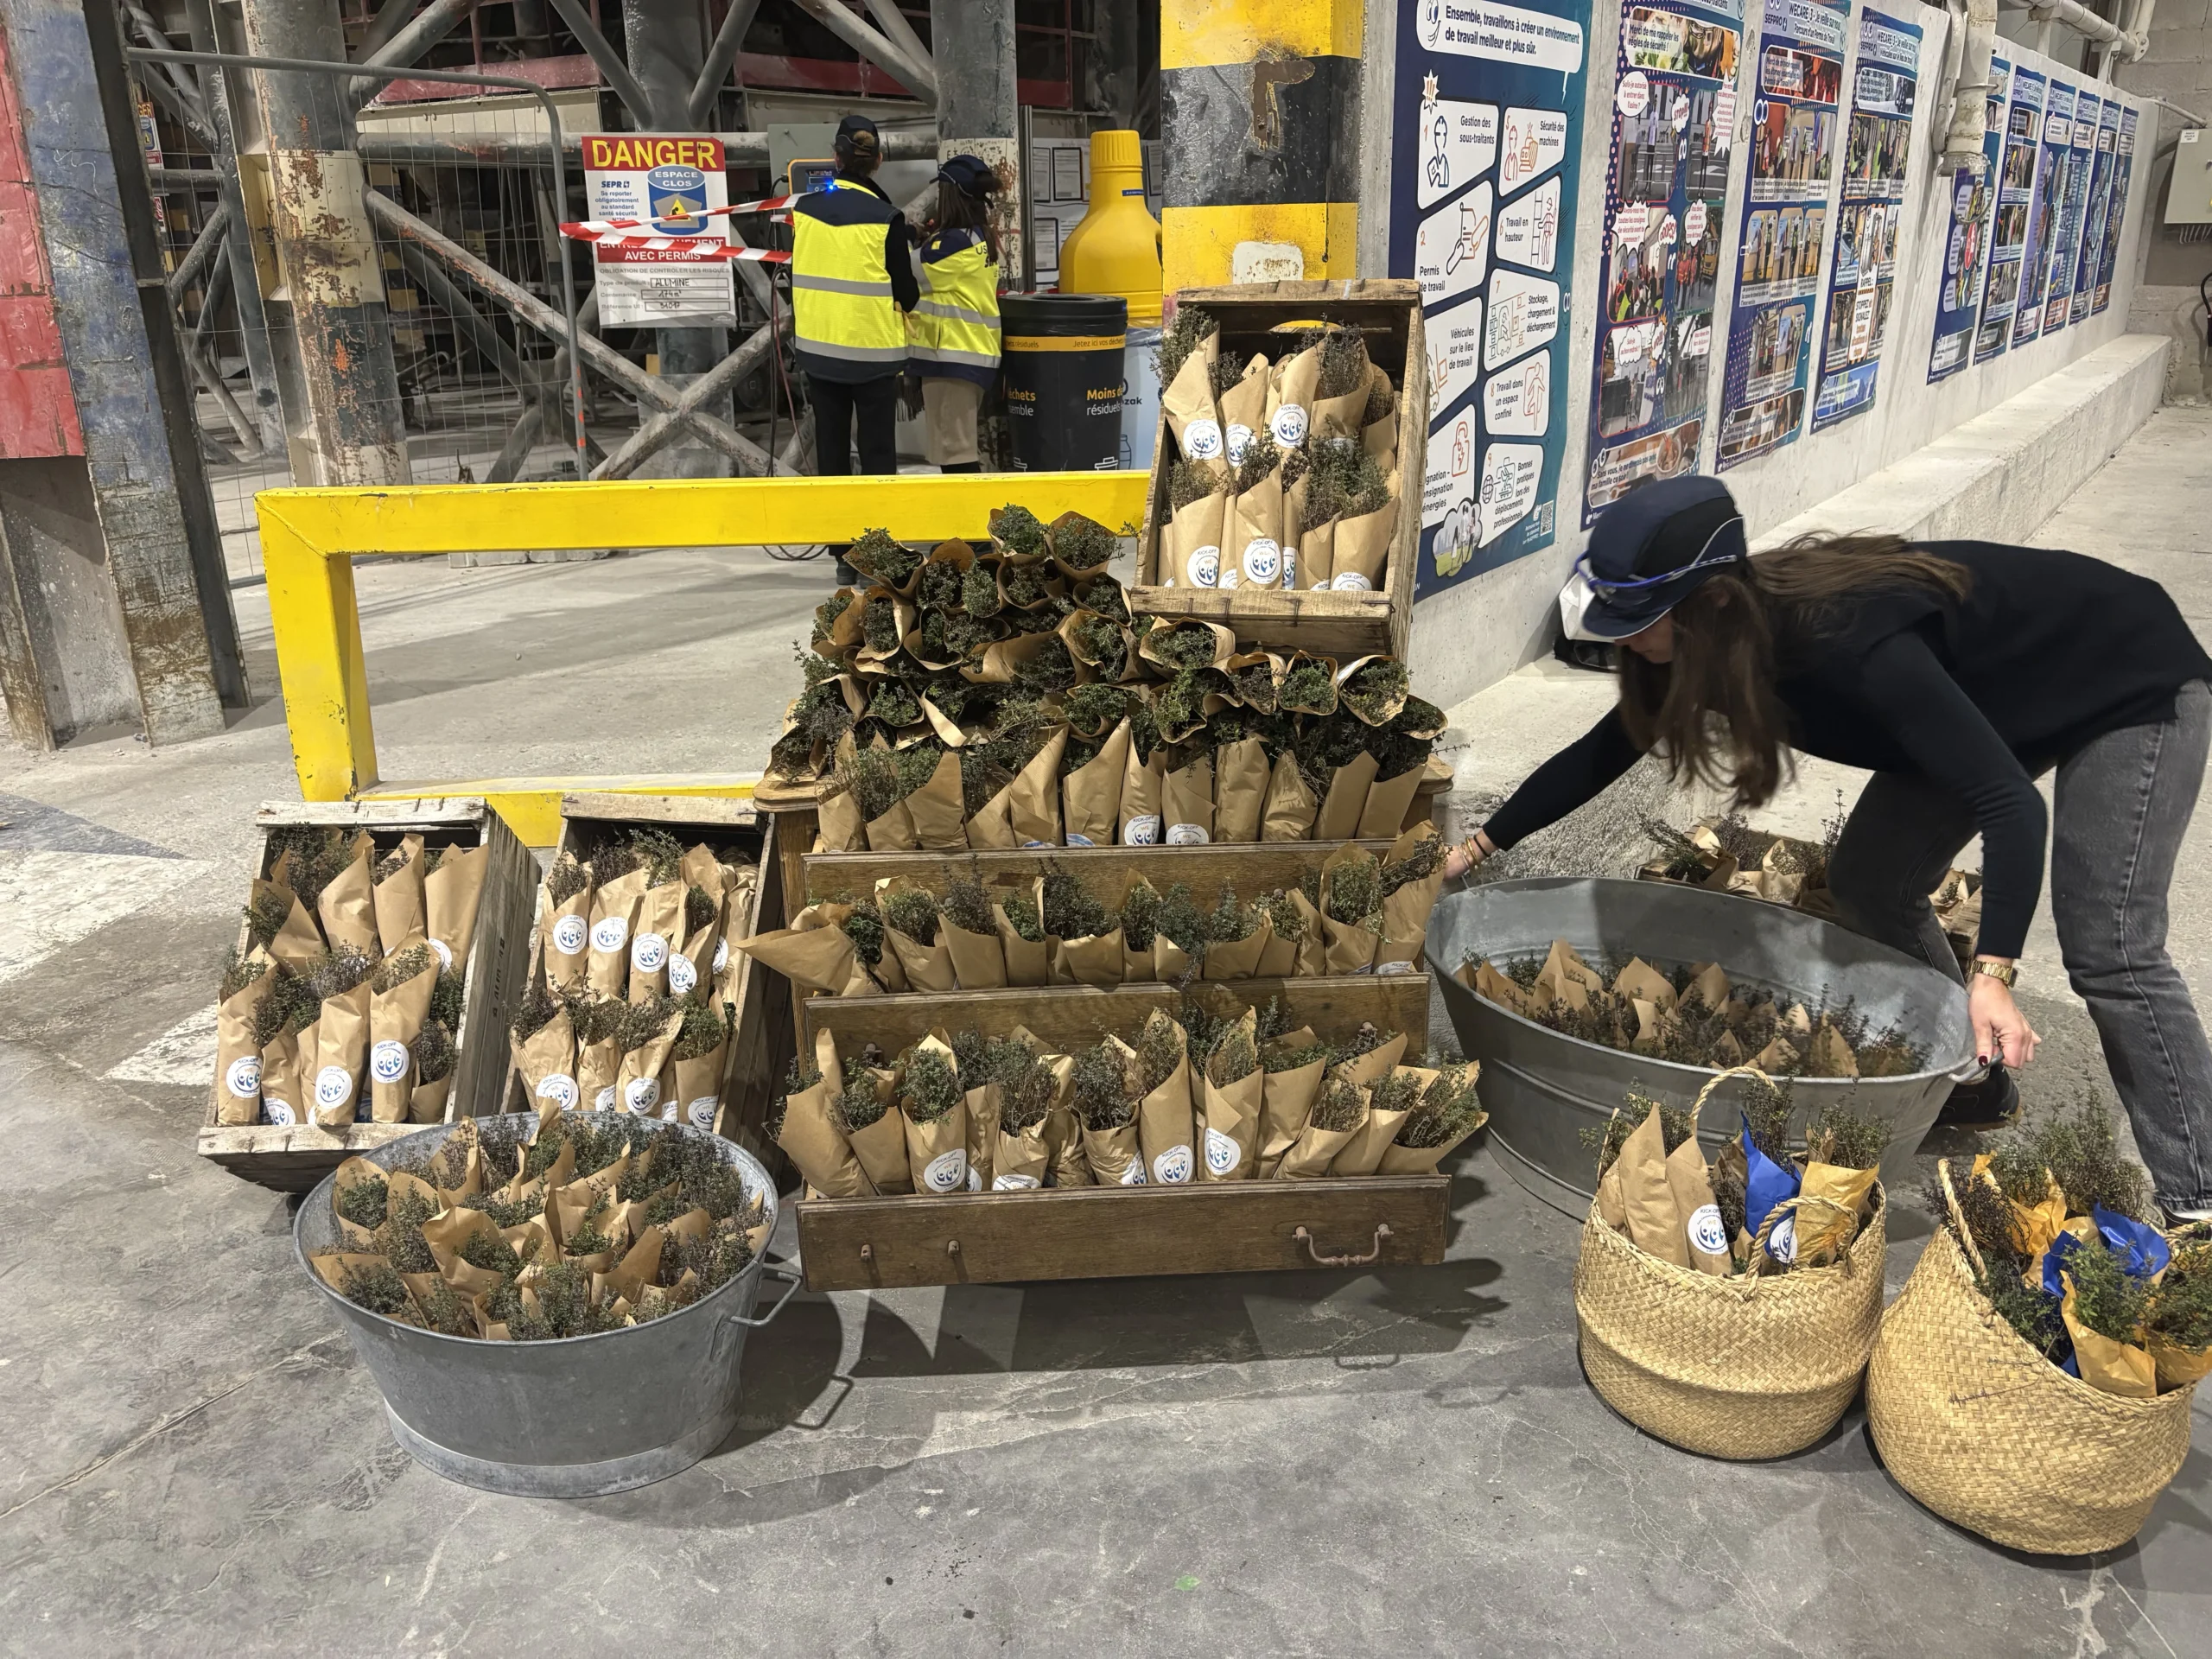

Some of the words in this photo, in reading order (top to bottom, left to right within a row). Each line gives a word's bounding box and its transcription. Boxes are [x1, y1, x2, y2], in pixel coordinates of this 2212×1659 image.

[1446, 6, 1482, 27] Ensemble,
[1484, 13, 1514, 30] travaillons
[1516, 18, 1519, 30] à
[1522, 21, 1536, 34] créer
[1537, 25, 1544, 35] un
[1545, 27, 1580, 44] environnement
[1765, 14, 1782, 26] SEFPRO
[1630, 24, 1642, 34] Merci
[1643, 25, 1648, 35] de
[1657, 29, 1673, 41] rappeler
[1446, 27, 1455, 41] de
[1457, 29, 1478, 43] travail
[1479, 33, 1503, 49] meilleur
[1505, 39, 1511, 50] et
[1512, 39, 1525, 54] plus
[1526, 41, 1536, 54] sûr.
[1643, 39, 1649, 48] de
[1461, 115, 1479, 127] Gestion
[1480, 116, 1491, 128] des
[1505, 115, 1510, 130] 5
[1540, 121, 1556, 131] Sécurité
[1459, 133, 1495, 144] sous-traitants
[1539, 137, 1559, 146] machines
[592, 140, 717, 168] DANGER
[1499, 219, 1503, 236] 6
[1506, 218, 1521, 226] Travail
[1421, 231, 1426, 245] 2
[1505, 232, 1523, 242] hauteur
[625, 251, 654, 260] AVEC
[658, 251, 701, 260] PERMIS
[1420, 266, 1440, 276] Permis
[655, 278, 690, 287] ALUMINE
[1428, 281, 1445, 291] travail
[1497, 280, 1501, 294] 7
[1529, 296, 1548, 305] Stockage,
[1527, 308, 1551, 319] chargement
[1552, 306, 1555, 315] &
[1451, 327, 1474, 339] Véhicules
[1527, 321, 1555, 333] déchargement
[1459, 344, 1463, 353] le
[1465, 341, 1474, 352] lieu
[1449, 360, 1455, 370] de
[1457, 356, 1472, 369] travail
[1087, 387, 1116, 401] Moins
[1491, 383, 1494, 397] 8
[1497, 380, 1511, 392] Travail
[1513, 378, 1523, 389] dans
[1008, 388, 1036, 402] échets
[1503, 395, 1518, 404] espace
[1087, 401, 1121, 416] résiduels
[1495, 409, 1512, 420] confiné
[1487, 453, 1491, 467] 9
[1517, 460, 1533, 471] Bonnes
[1516, 472, 1535, 486] pratiques
[1599, 478, 1612, 487] famille
[1422, 499, 1446, 513] énergies
[1495, 499, 1523, 515] déplacements
[1493, 510, 1522, 530] professionnels
[543, 1076, 563, 1084] KICK-OFF
[936, 1151, 957, 1164] KICK-OFF
[1162, 1146, 1181, 1158] KICK-OFF
